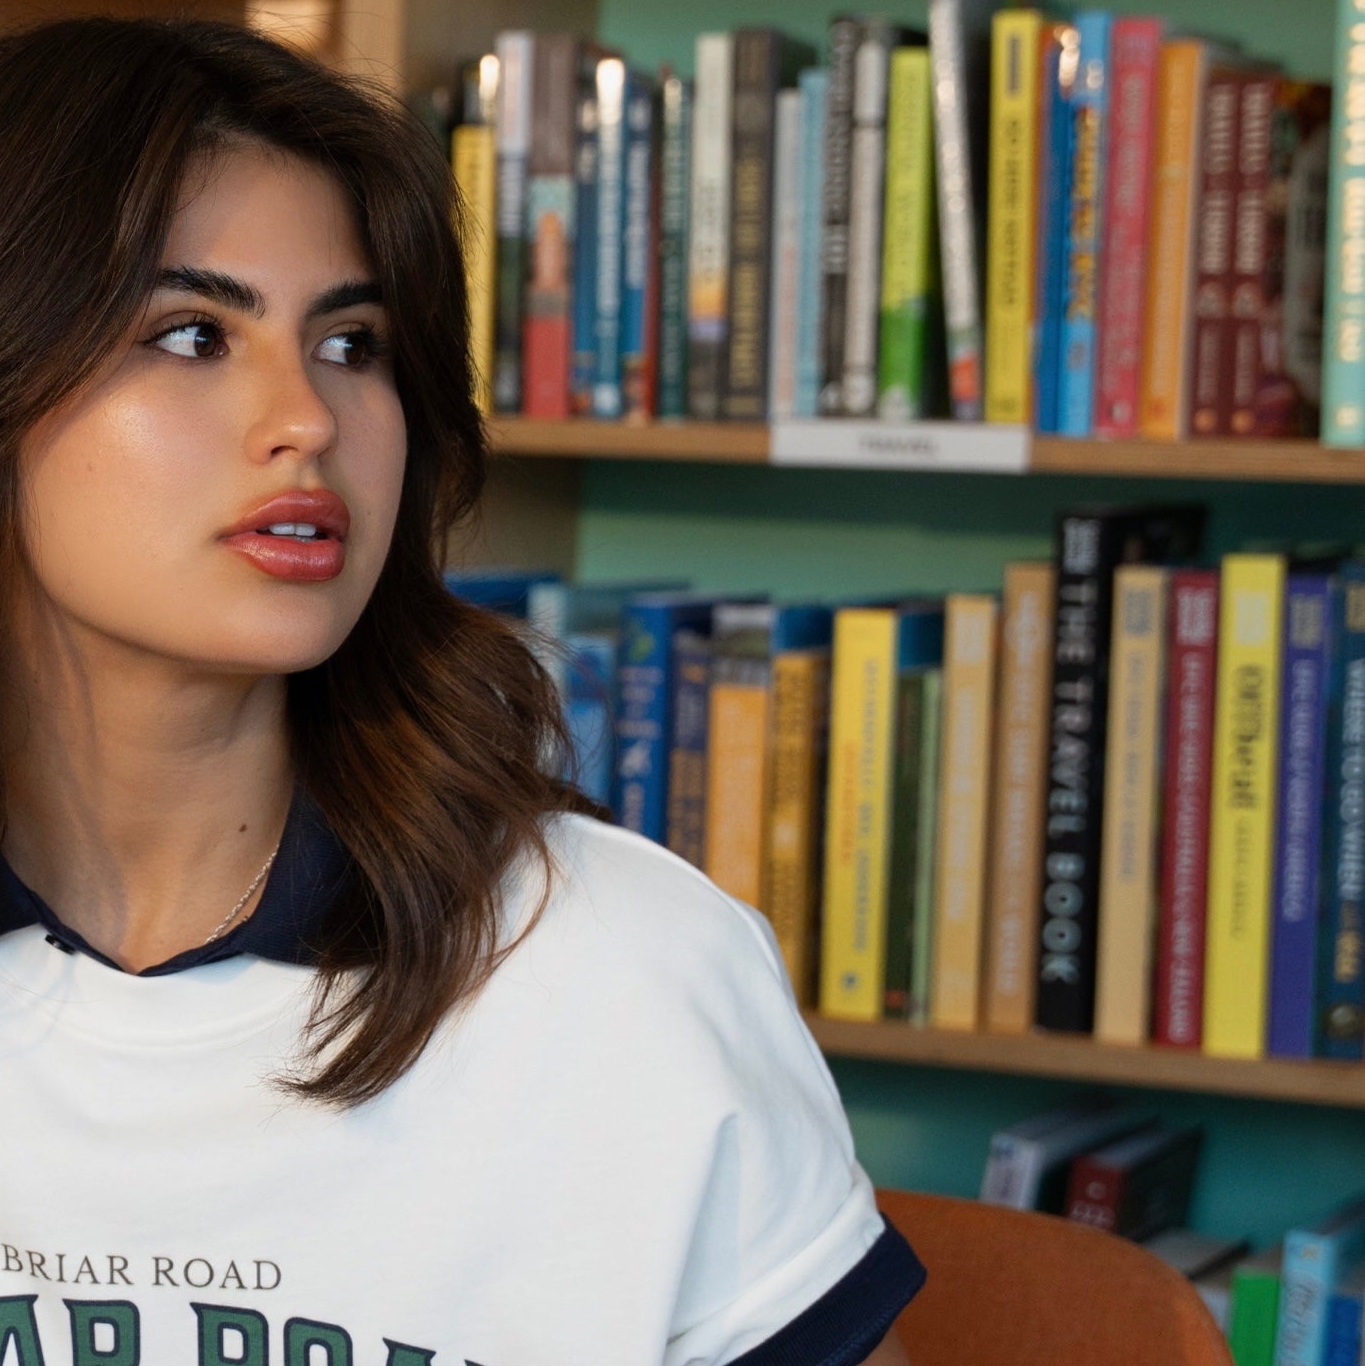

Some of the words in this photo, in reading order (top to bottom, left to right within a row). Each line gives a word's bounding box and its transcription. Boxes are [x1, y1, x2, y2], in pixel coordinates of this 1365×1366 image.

[1059, 579, 1098, 665] THE
[1050, 675, 1093, 840] TRAVEL
[1039, 852, 1083, 985] BOOK
[1, 1242, 131, 1286] BRIAR
[152, 1255, 283, 1291] ROAD
